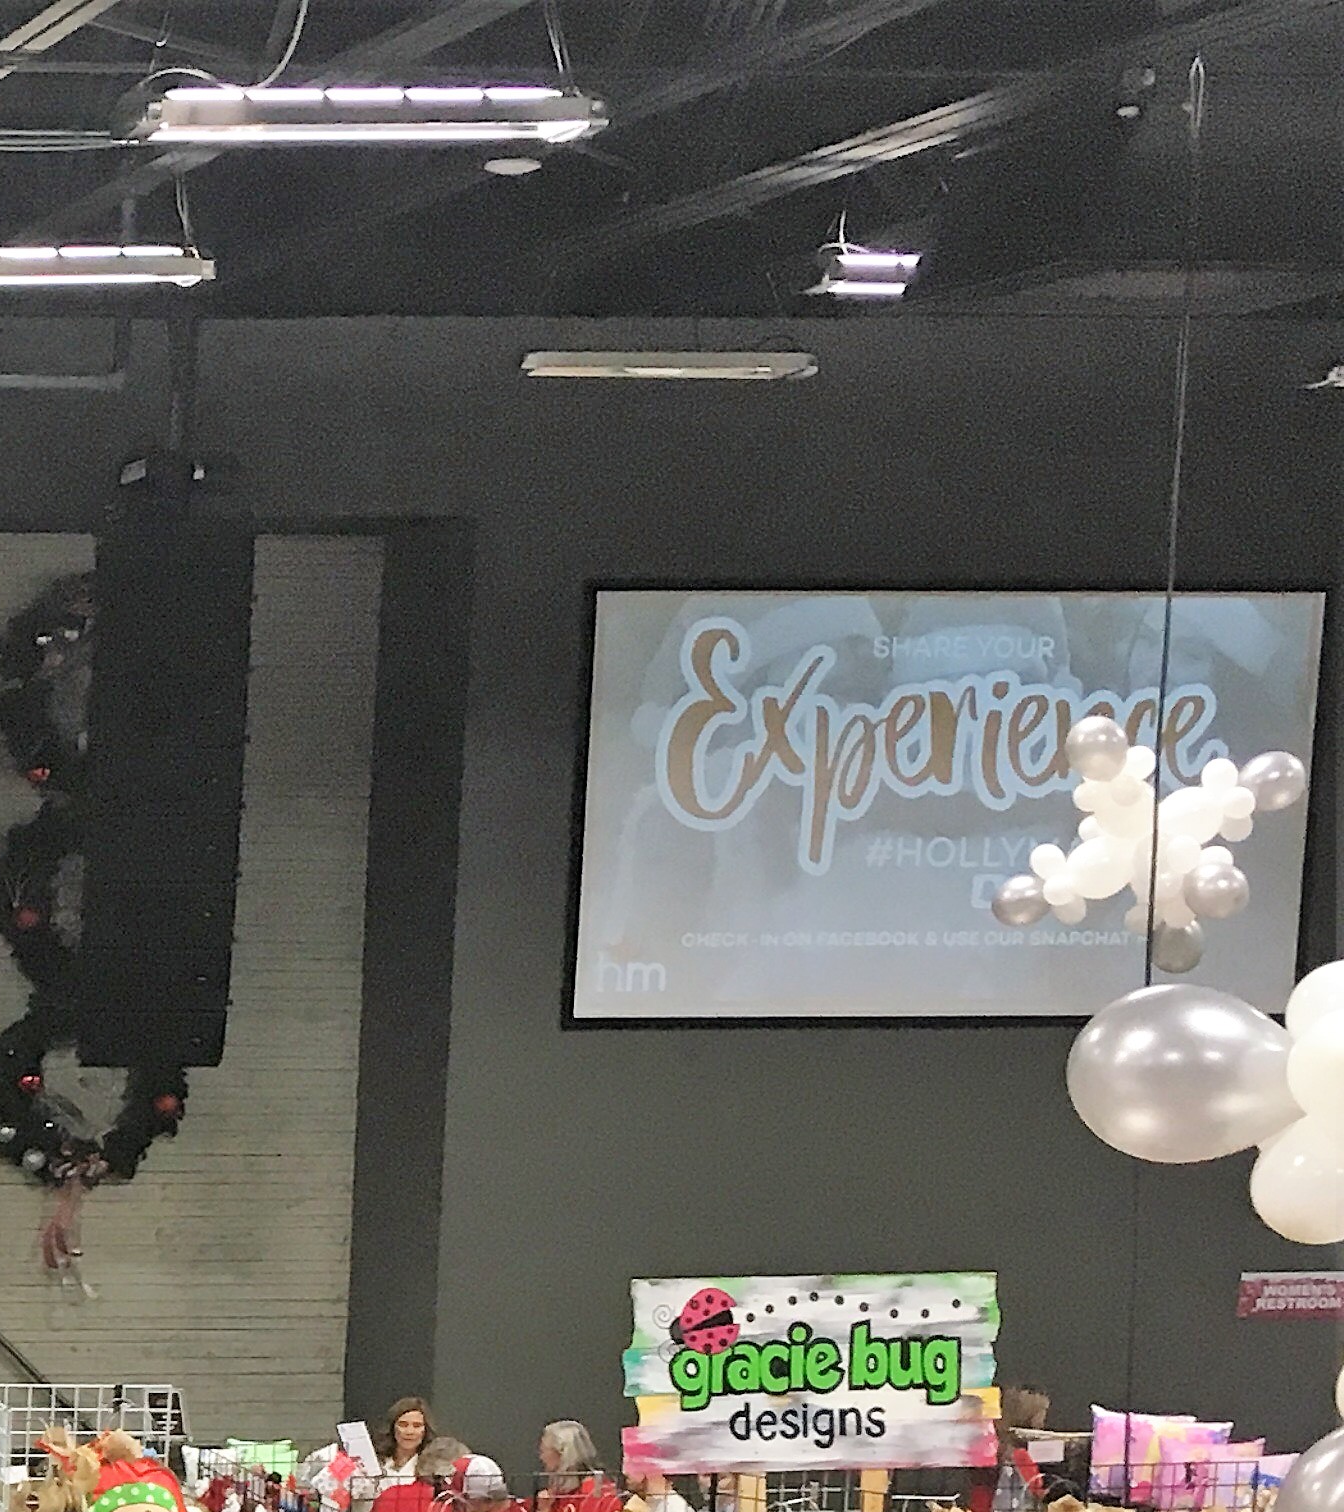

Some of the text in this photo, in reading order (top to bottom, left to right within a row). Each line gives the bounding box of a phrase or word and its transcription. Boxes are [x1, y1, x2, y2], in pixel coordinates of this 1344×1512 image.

[873, 635, 1055, 659] SHARE YOUR
[865, 835, 1057, 868] #HOLLY
[815, 930, 919, 948] FACEBOOK
[943, 930, 979, 947] USE
[984, 930, 1025, 947] OUR
[1030, 929, 1132, 947] SNAPCHAT
[592, 953, 666, 992] hm
[669, 1319, 962, 1411] gracie bug
[728, 1402, 886, 1449] designs
